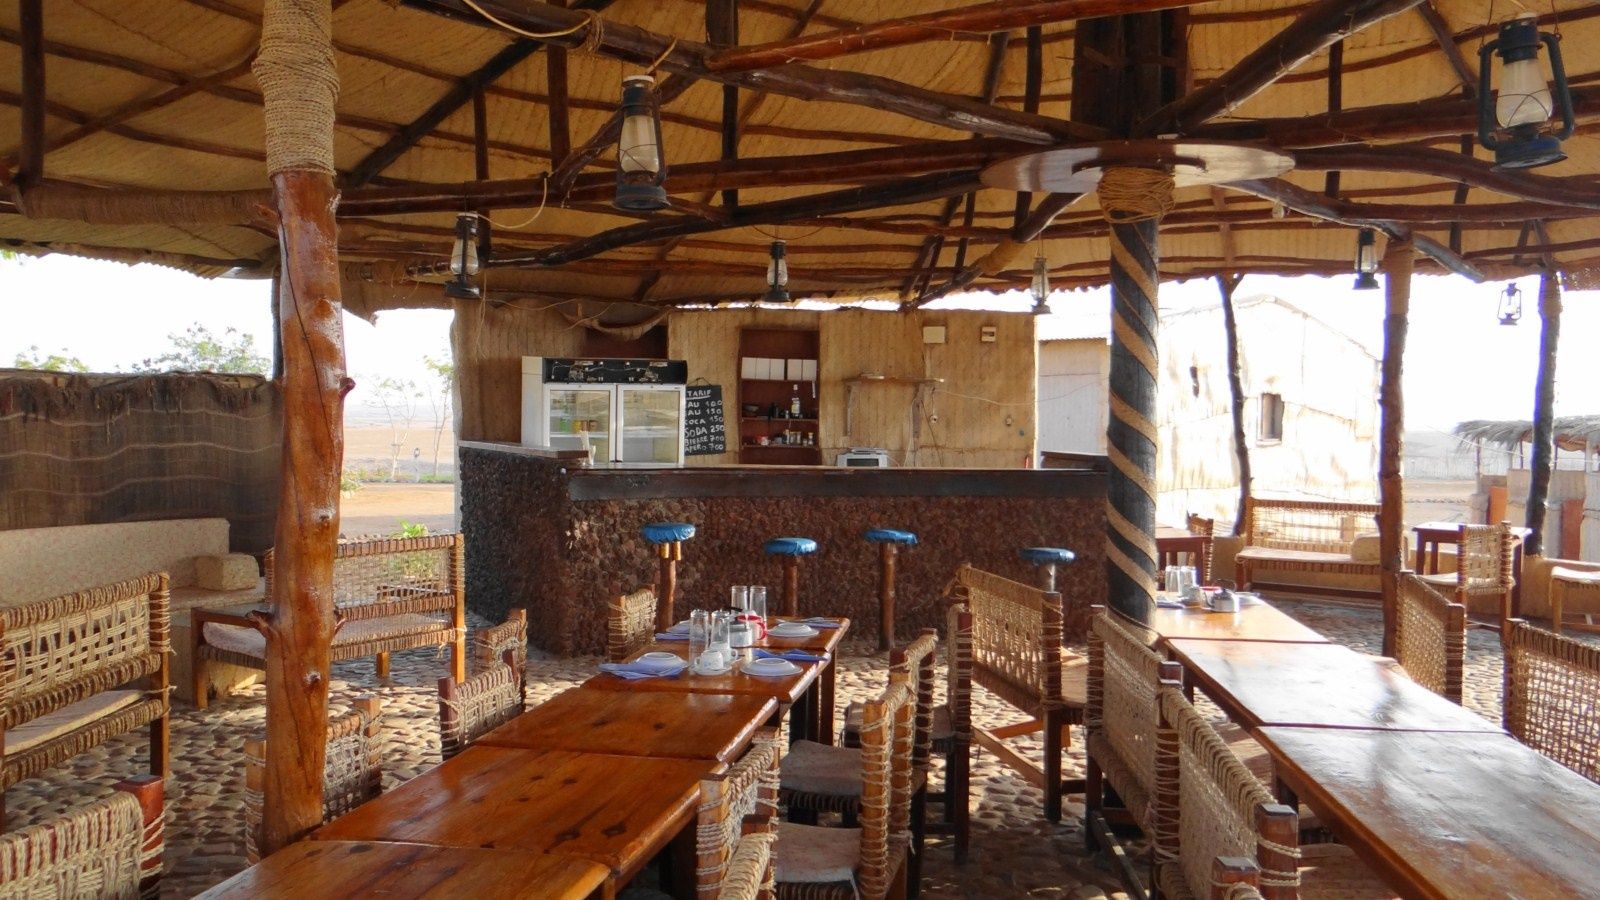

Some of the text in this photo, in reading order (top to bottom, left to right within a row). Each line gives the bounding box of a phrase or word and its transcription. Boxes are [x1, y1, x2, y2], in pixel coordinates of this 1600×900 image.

[687, 389, 711, 397] TARIF
[684, 425, 725, 438] SODA 250
